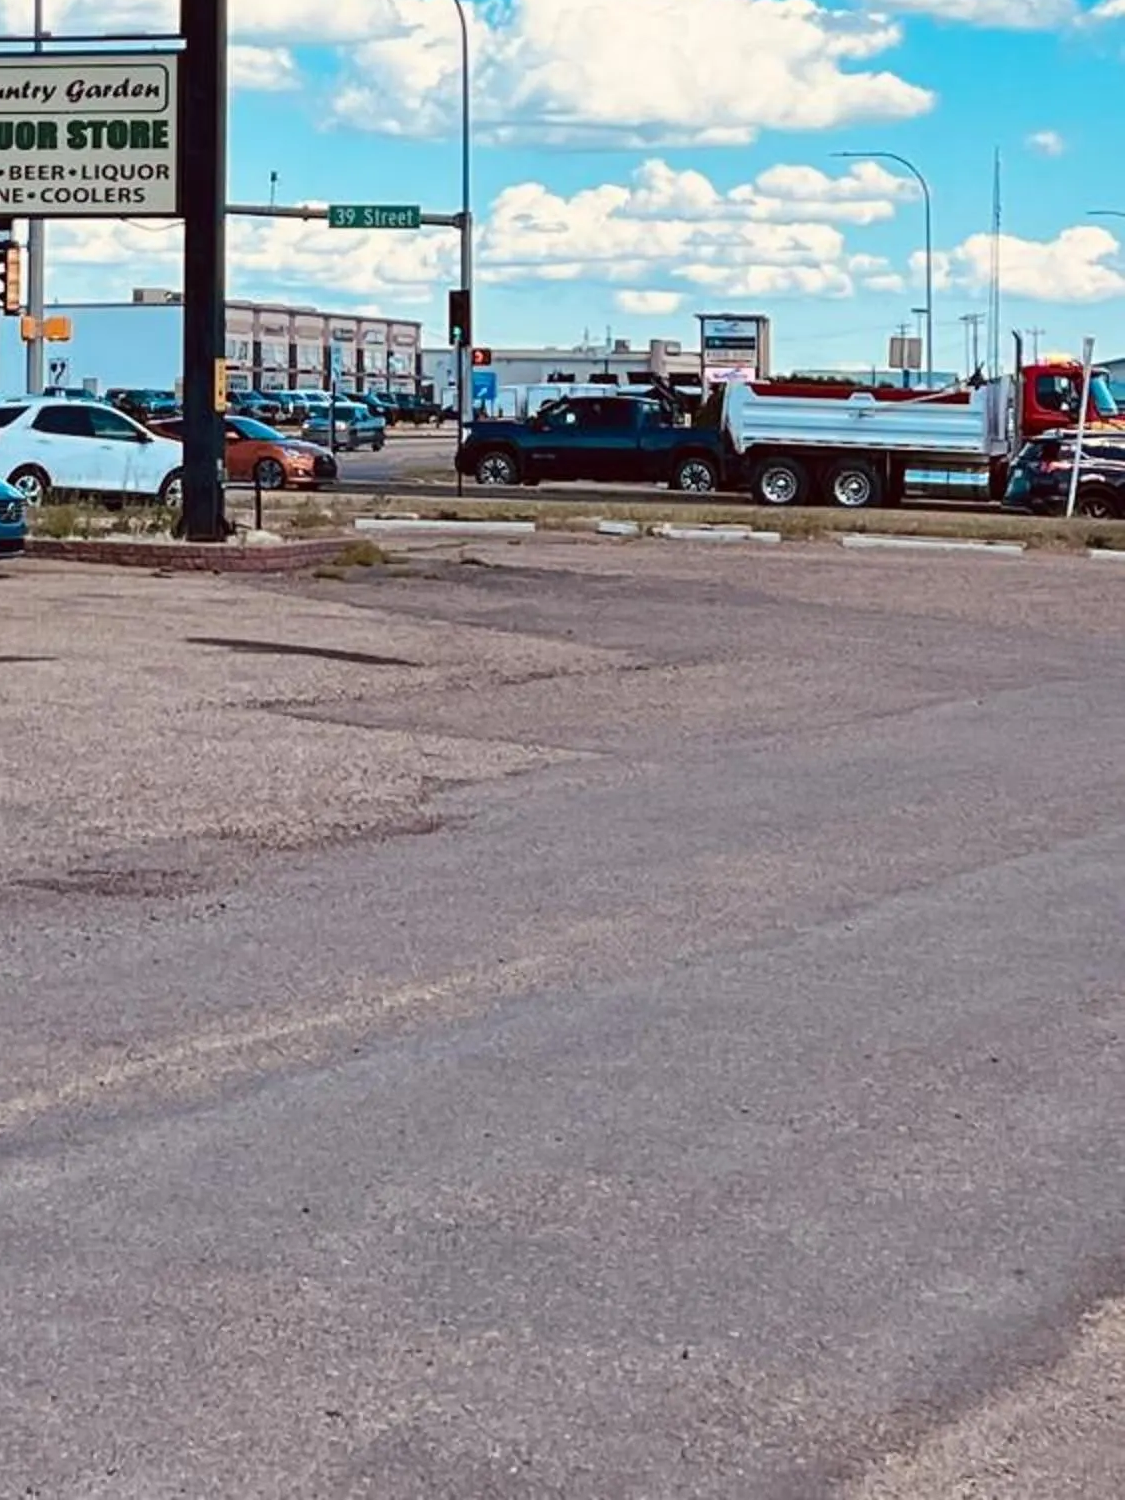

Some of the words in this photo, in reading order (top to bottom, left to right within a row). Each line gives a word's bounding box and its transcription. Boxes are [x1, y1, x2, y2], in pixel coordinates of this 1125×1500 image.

[65, 77, 160, 104] Garden
[66, 119, 169, 150] STORE
[9, 164, 65, 181] BEER
[81, 163, 169, 182] LIQUOR
[40, 186, 146, 204] COOLERS
[336, 207, 355, 226] 39
[363, 207, 414, 226] Street
